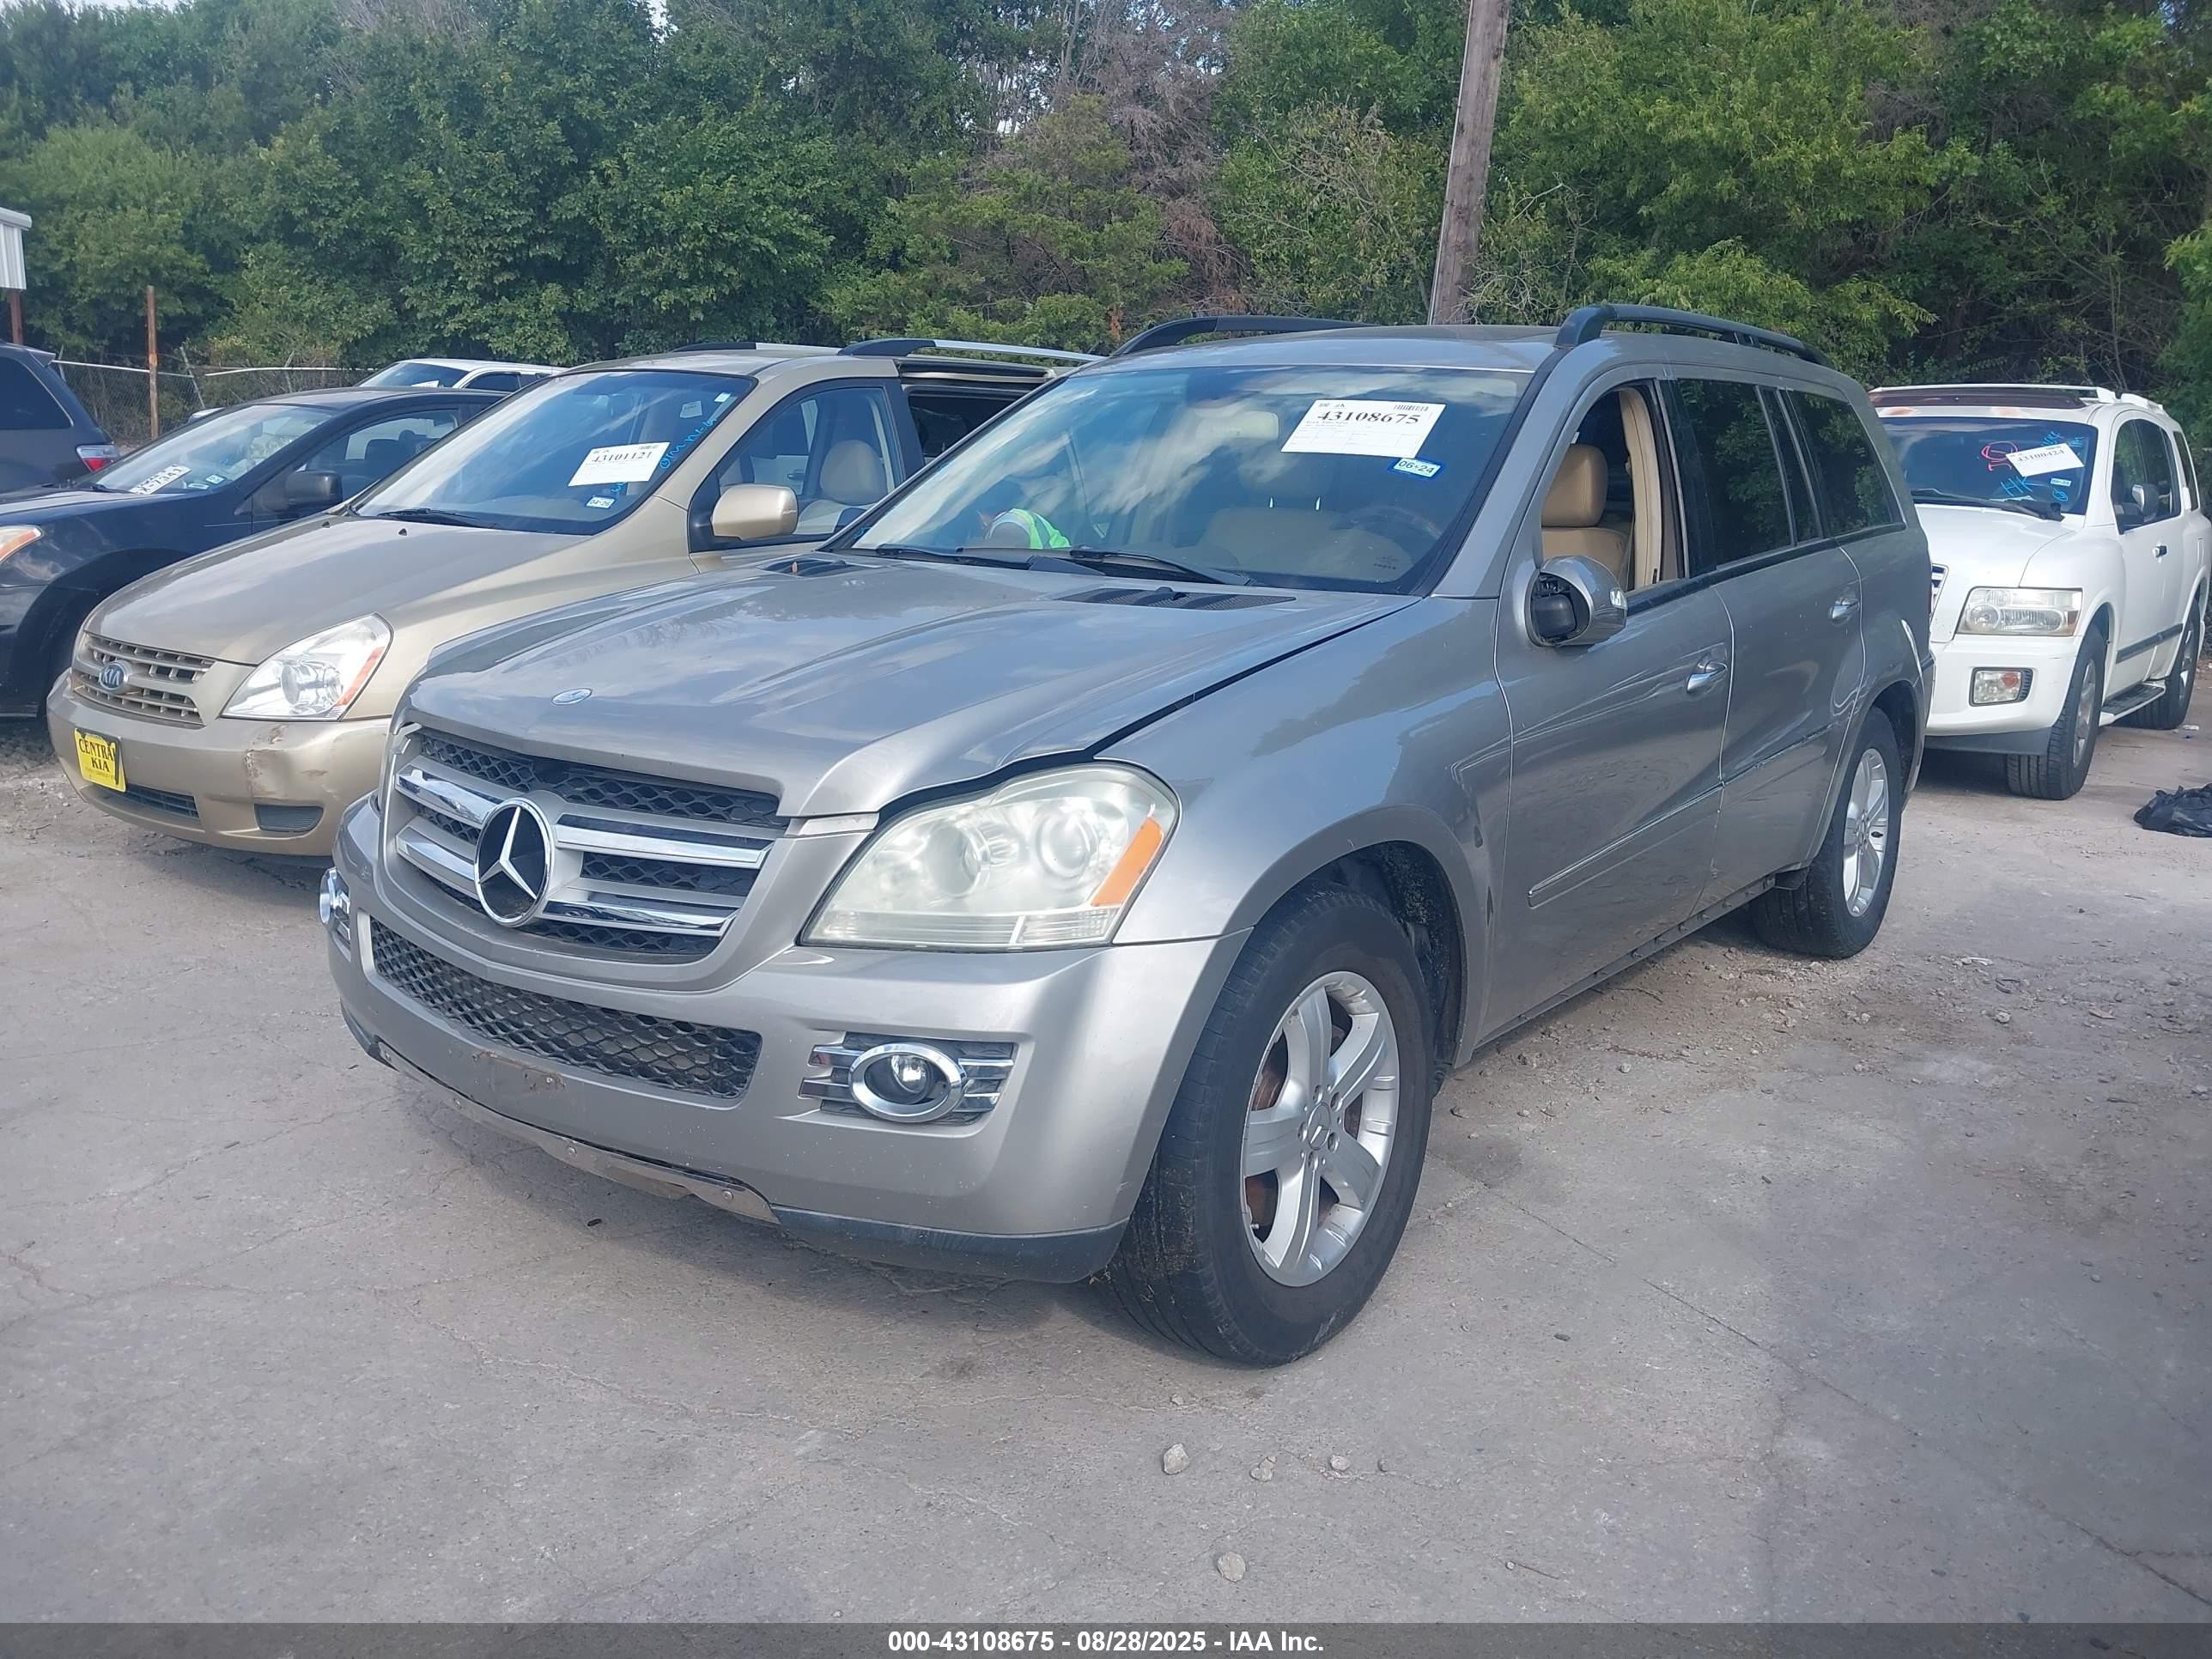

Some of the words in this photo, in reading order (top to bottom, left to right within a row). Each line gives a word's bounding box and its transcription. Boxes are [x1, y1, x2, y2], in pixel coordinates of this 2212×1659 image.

[1317, 410, 1421, 424] 43108675
[592, 451, 653, 463] 43101121
[102, 666, 120, 686] KIA
[91, 757, 110, 773] KIA
